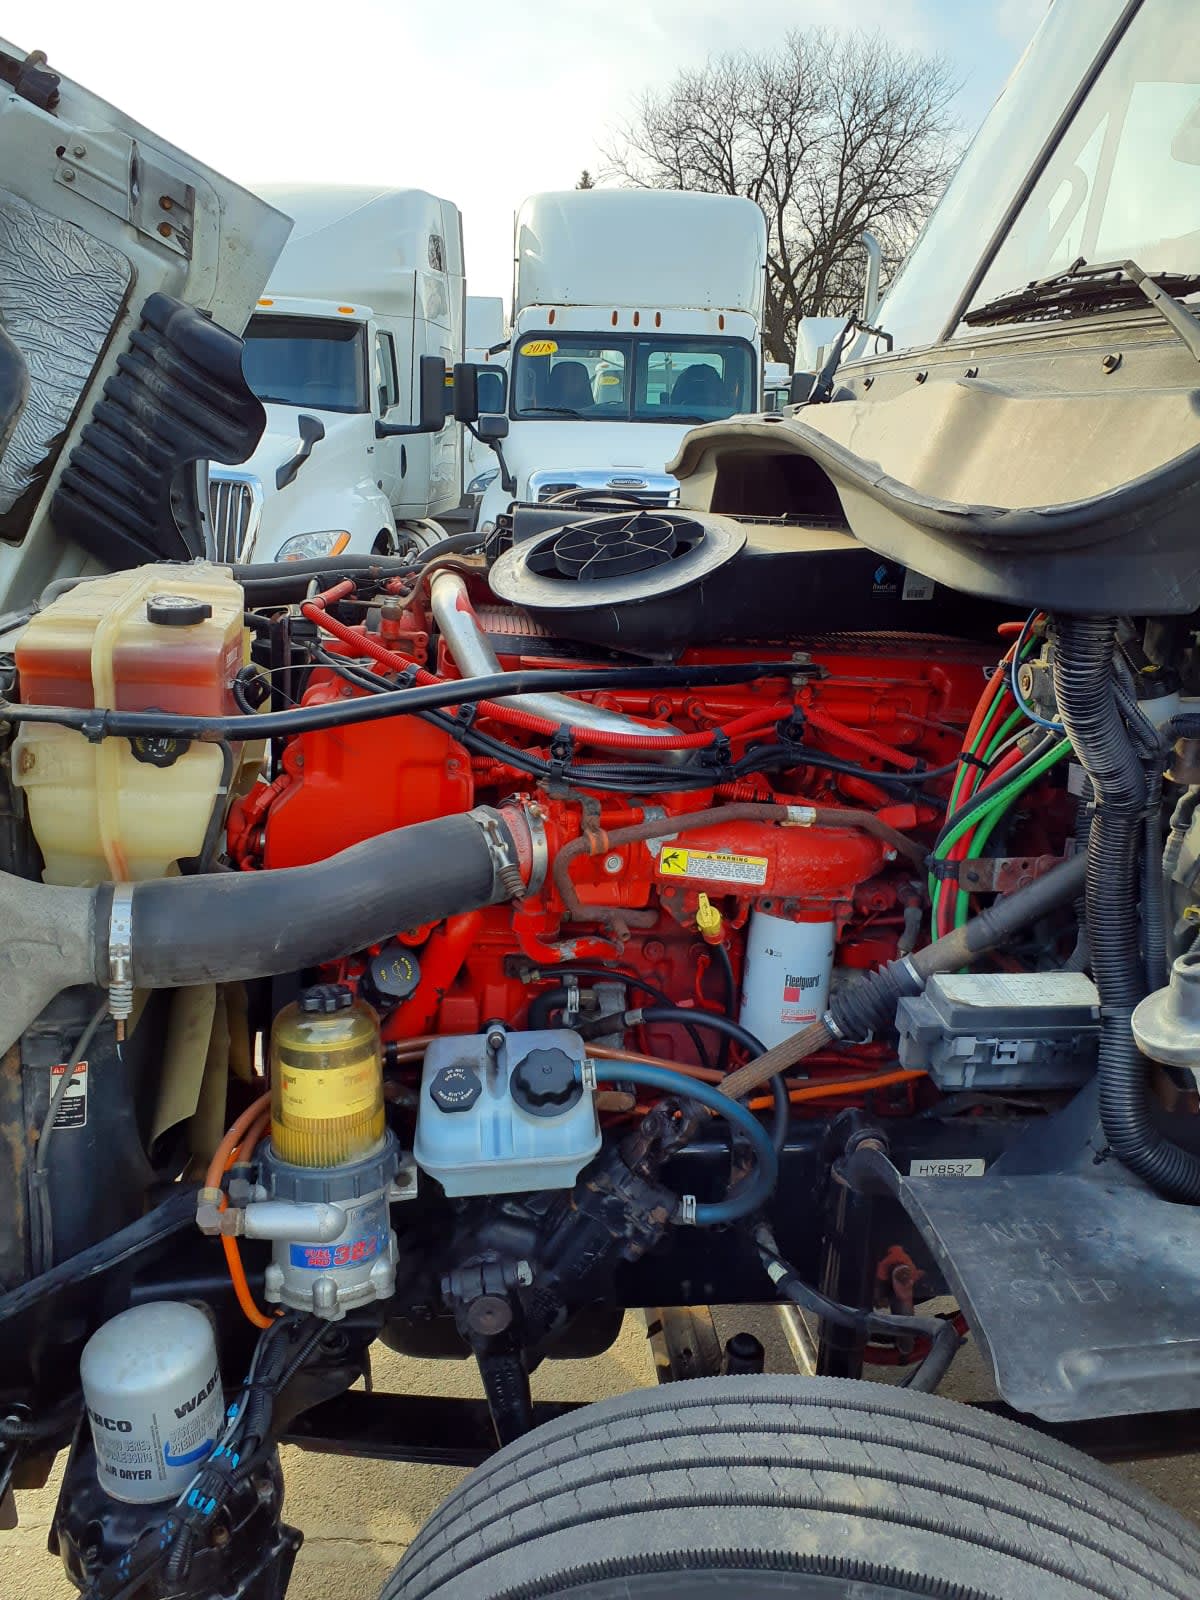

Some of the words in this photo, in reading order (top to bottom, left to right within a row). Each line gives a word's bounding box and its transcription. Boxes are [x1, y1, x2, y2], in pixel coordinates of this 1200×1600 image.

[526, 342, 552, 354] 2018
[716, 855, 749, 863] WARNING
[784, 974, 821, 991] Fleetguard
[919, 1164, 972, 1174] HY8537
[305, 1248, 331, 1258] FUEL
[309, 1258, 331, 1267] PRO
[1010, 1277, 1117, 1305] STEP
[104, 1463, 118, 1477] AIR
[119, 1469, 152, 1481] DRYER
